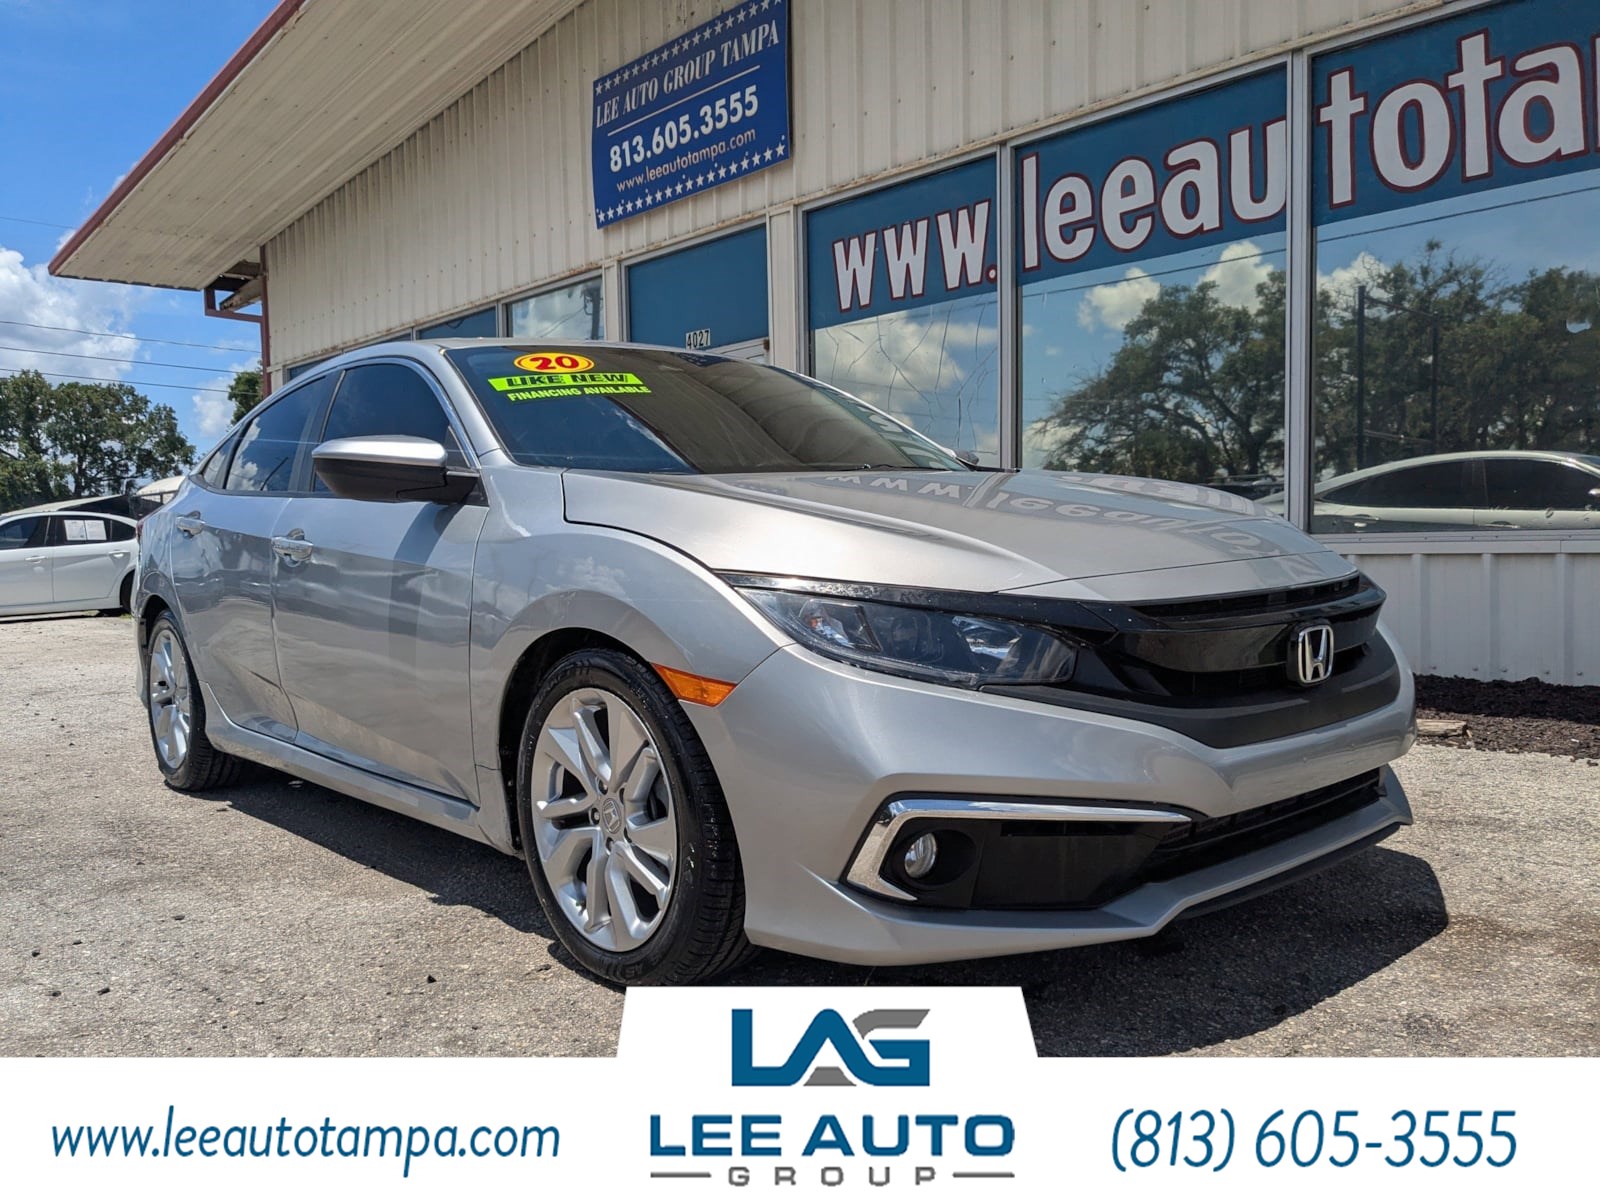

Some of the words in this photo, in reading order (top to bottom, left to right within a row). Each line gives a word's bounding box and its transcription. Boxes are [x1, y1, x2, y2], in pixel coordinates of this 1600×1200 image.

[596, 96, 619, 128] LEE
[622, 78, 659, 114] AUTO
[663, 50, 716, 94] GROUP
[720, 19, 779, 67] TAMPA
[609, 85, 758, 172] 813.605.3555
[616, 128, 756, 192] www.leeautotampa.com
[687, 330, 709, 349] 4027
[530, 355, 580, 371] 20
[506, 374, 564, 387] LIKE
[571, 372, 629, 384] NEW
[507, 387, 582, 402] FINANCING
[584, 385, 651, 396] AVAILABLE
